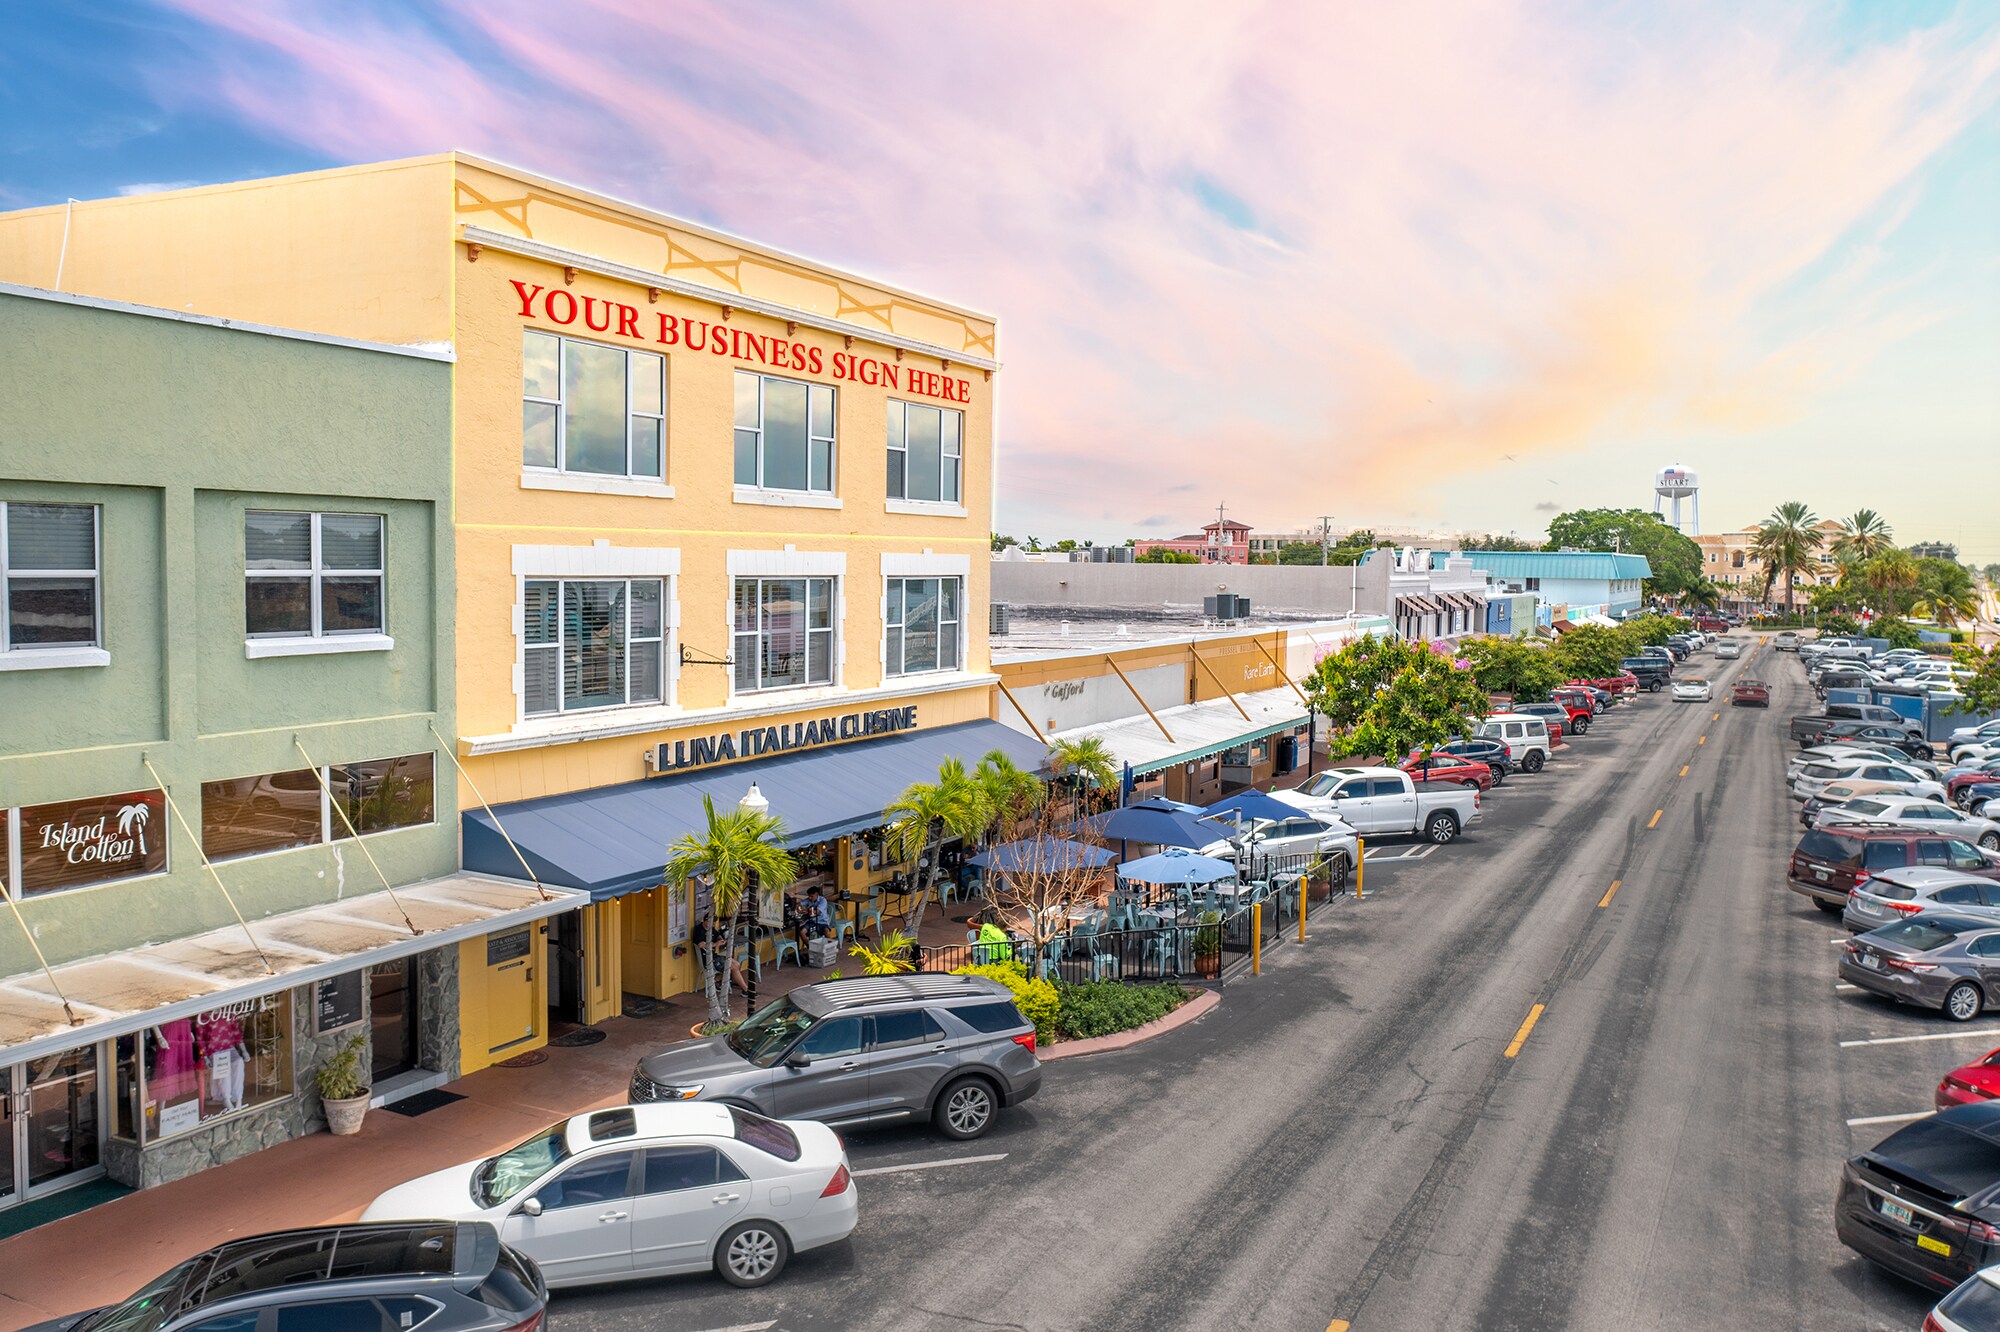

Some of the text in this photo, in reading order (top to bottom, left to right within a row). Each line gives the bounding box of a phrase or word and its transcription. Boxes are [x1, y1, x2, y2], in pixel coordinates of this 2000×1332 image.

[508, 279, 972, 404] YOUR BUSINESS SIGN HERE
[1660, 479, 1689, 487] STUART
[1243, 661, 1275, 681] Rare Earth
[1051, 681, 1085, 701] Gafford
[656, 705, 918, 772] LUNA ITALIAN CUISINE
[39, 816, 106, 851] Island
[67, 832, 135, 864] Cotton
